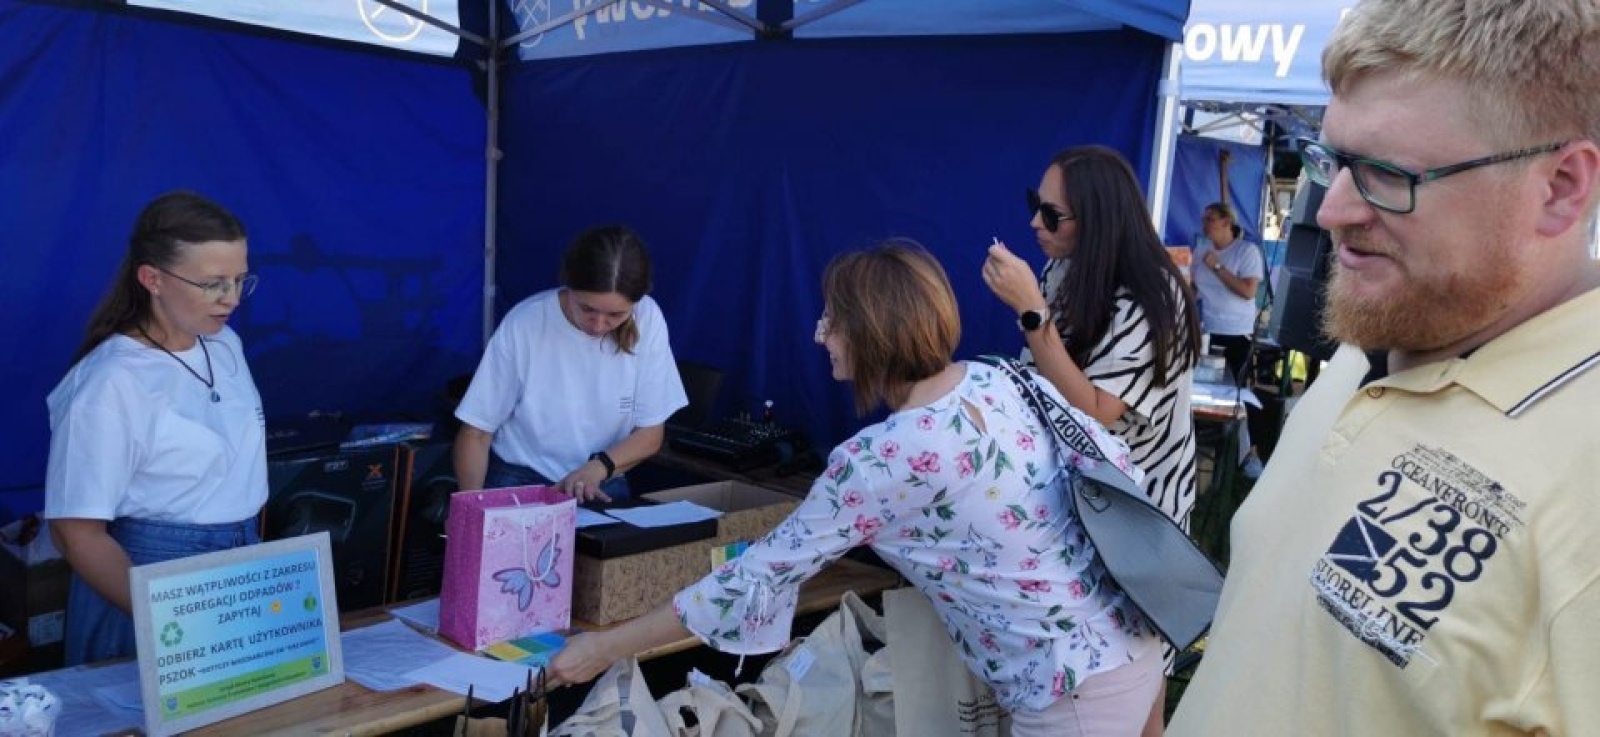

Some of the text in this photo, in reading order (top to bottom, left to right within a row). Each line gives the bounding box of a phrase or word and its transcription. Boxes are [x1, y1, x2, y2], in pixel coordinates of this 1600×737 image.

[1391, 454, 1510, 539] OCEANFRONT
[151, 561, 316, 603] MASZ WĄTPLIWOŚCI Z ZAKRESU
[172, 594, 236, 617] SEGREGACJI
[239, 583, 293, 601] ODPADÓW
[1367, 547, 1456, 631] 52
[217, 604, 262, 625] ZAPYTAJ
[157, 646, 207, 668] ODBIERZ
[211, 637, 245, 655] KARTĘ
[249, 618, 323, 645] UŻYTKOWNIKA
[159, 668, 196, 685] PSZOK
